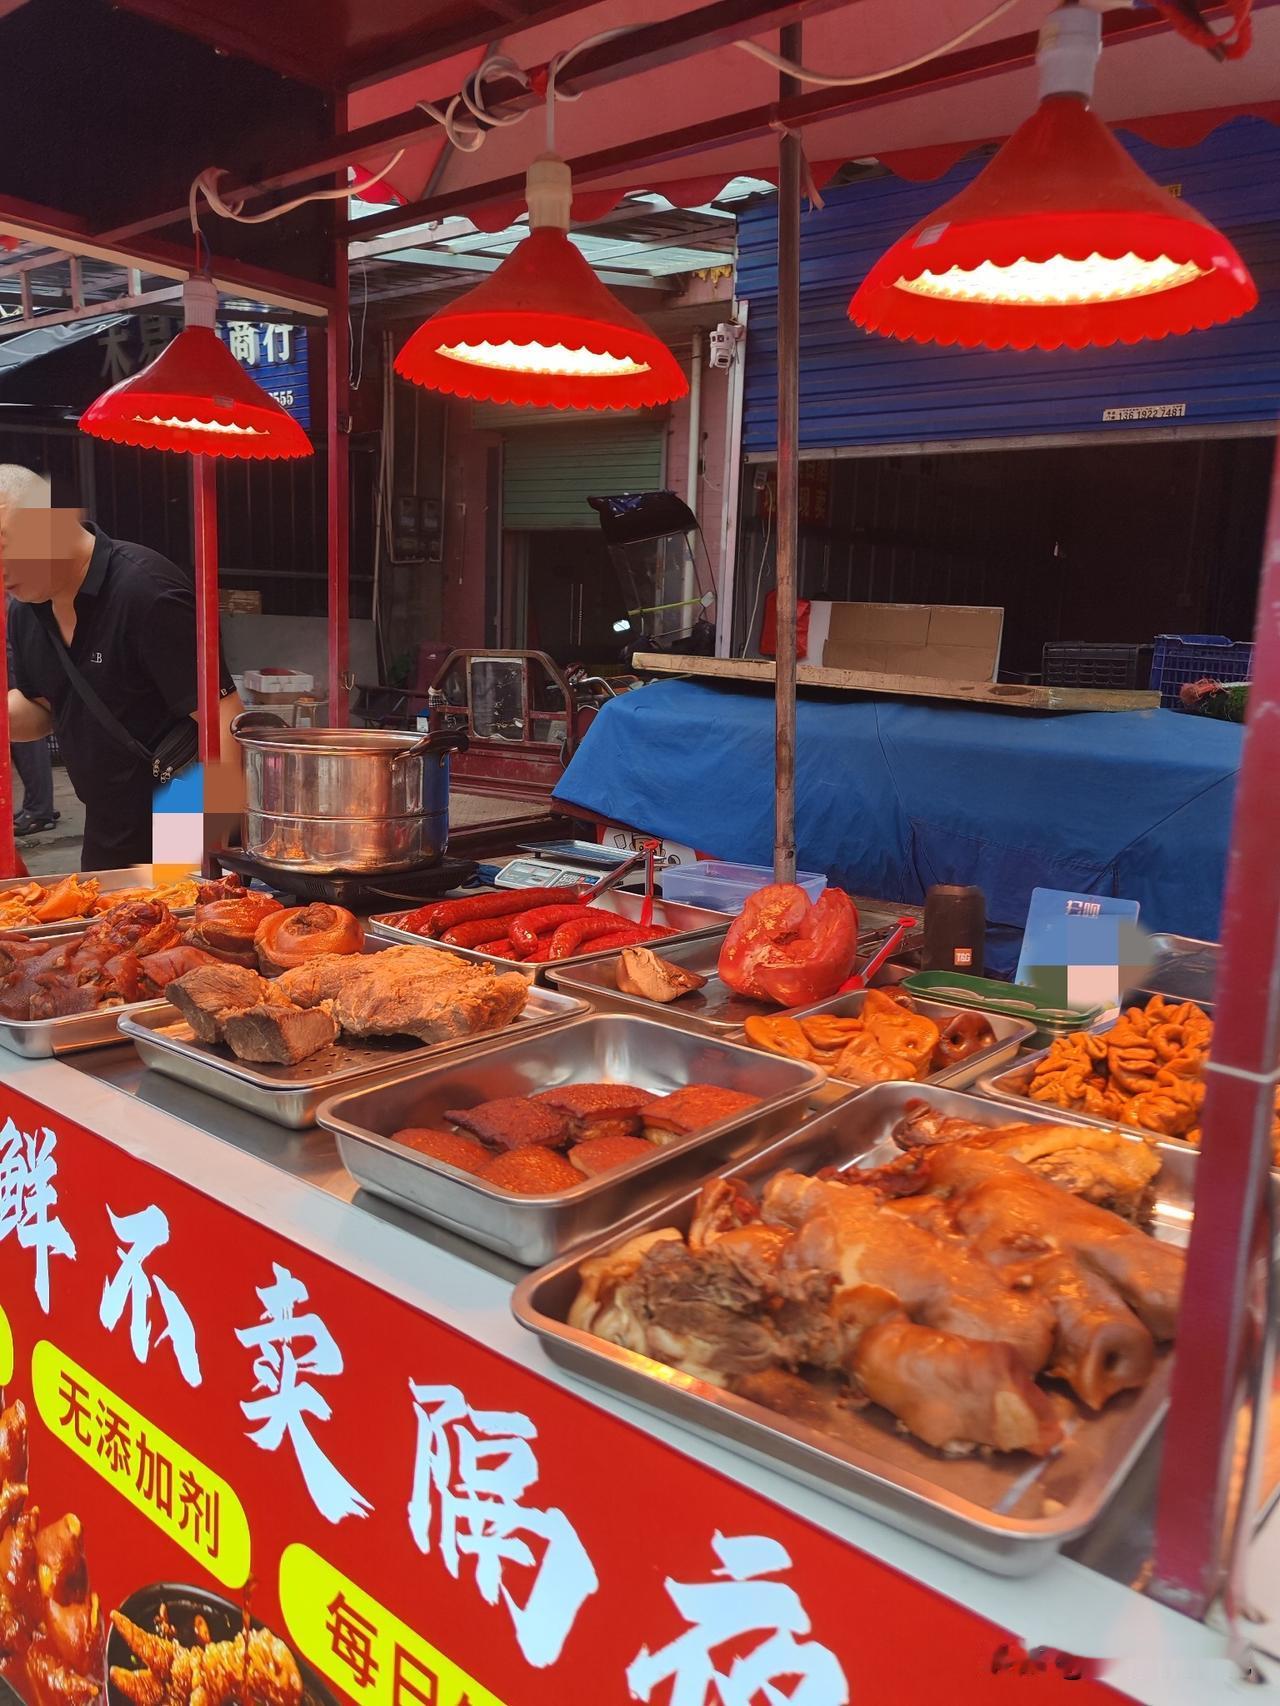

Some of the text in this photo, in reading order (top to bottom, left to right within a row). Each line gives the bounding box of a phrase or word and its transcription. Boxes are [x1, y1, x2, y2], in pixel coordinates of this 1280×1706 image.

[0, 1116, 850, 1706] 鲜不卖隔夜
[58, 1370, 219, 1558] 无添加剂
[326, 1591, 476, 1706] 每日
